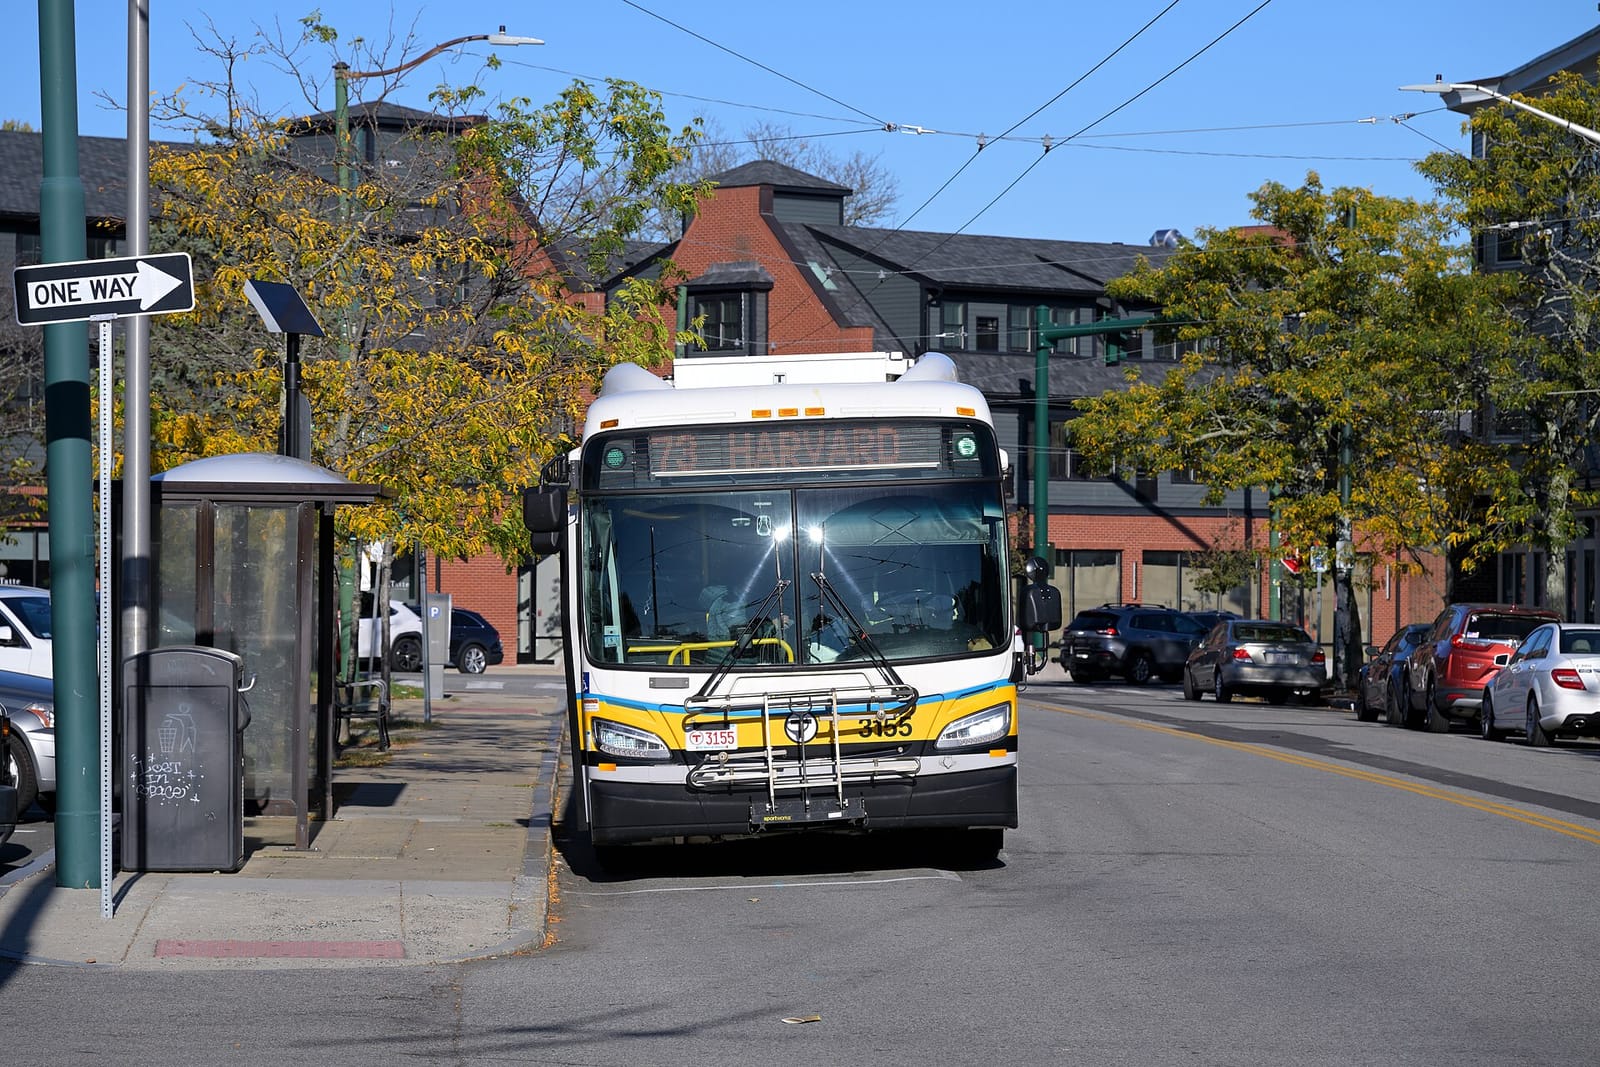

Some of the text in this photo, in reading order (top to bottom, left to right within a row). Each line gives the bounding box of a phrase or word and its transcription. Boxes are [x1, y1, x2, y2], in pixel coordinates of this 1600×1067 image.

[34, 276, 138, 305] ONE WAY
[774, 374, 786, 384] T
[727, 426, 900, 469] HARVARD
[431, 607, 439, 617] P
[858, 718, 913, 738] 3155
[705, 731, 735, 745] 3155
